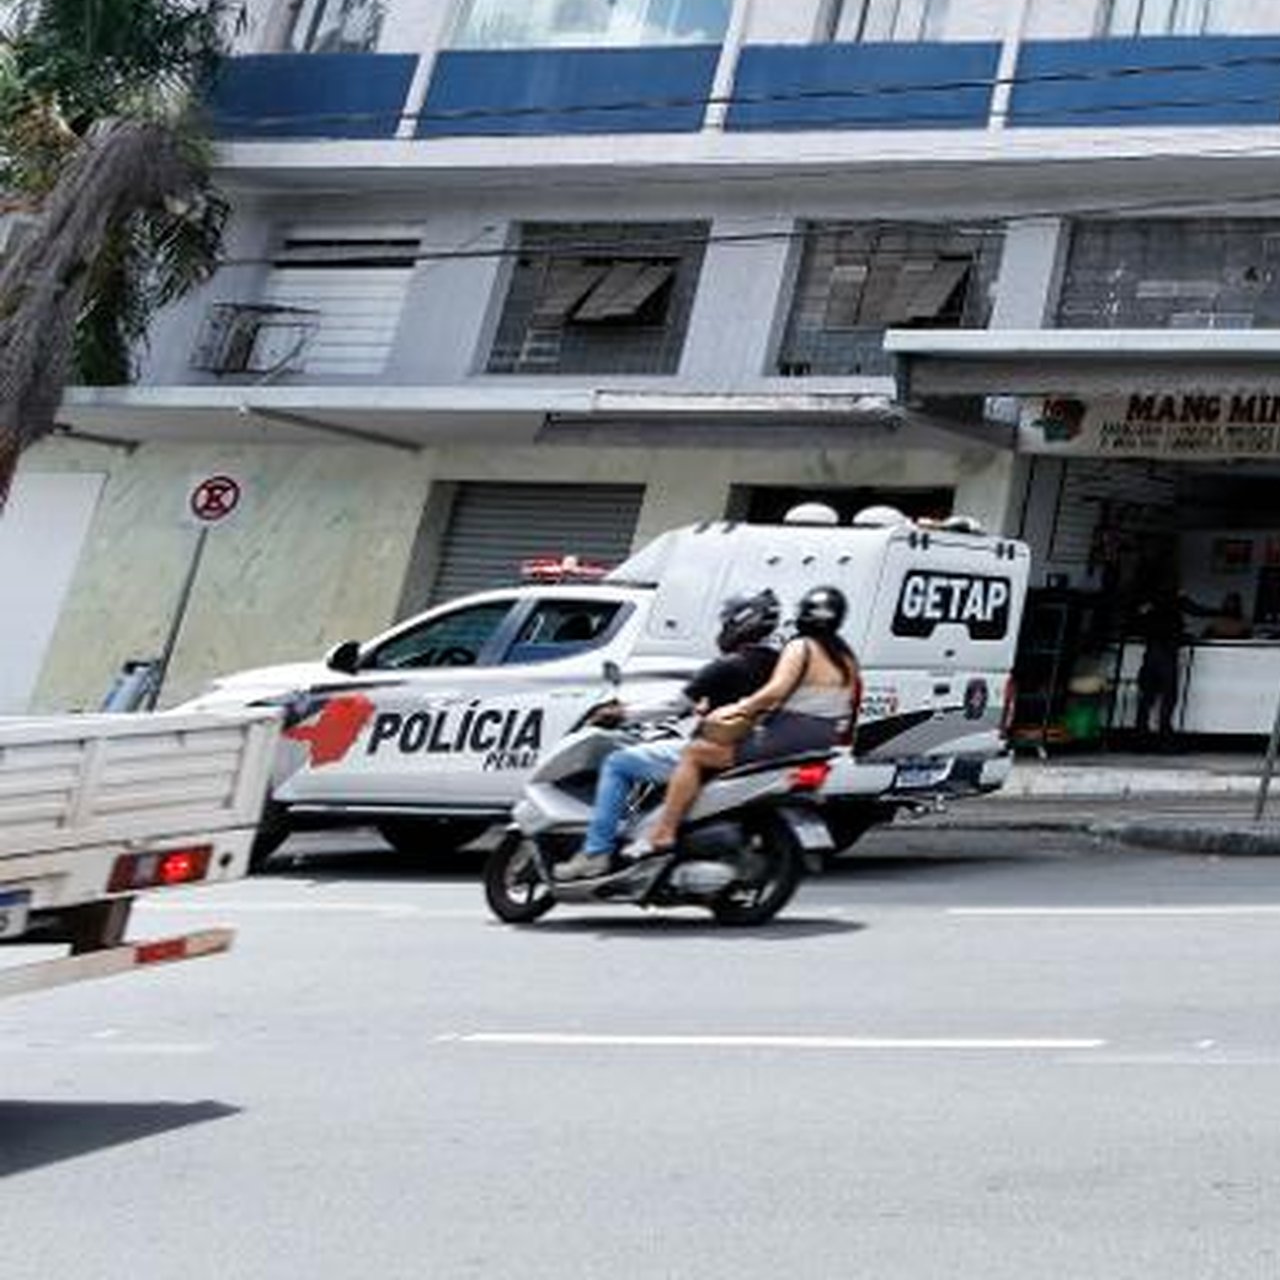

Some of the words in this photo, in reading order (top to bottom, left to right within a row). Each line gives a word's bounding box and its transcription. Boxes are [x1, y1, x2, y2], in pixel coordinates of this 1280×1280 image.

[1126, 393, 1221, 423] MANG
[901, 575, 1007, 621] GETAP
[366, 699, 544, 755] POLÍCIA
